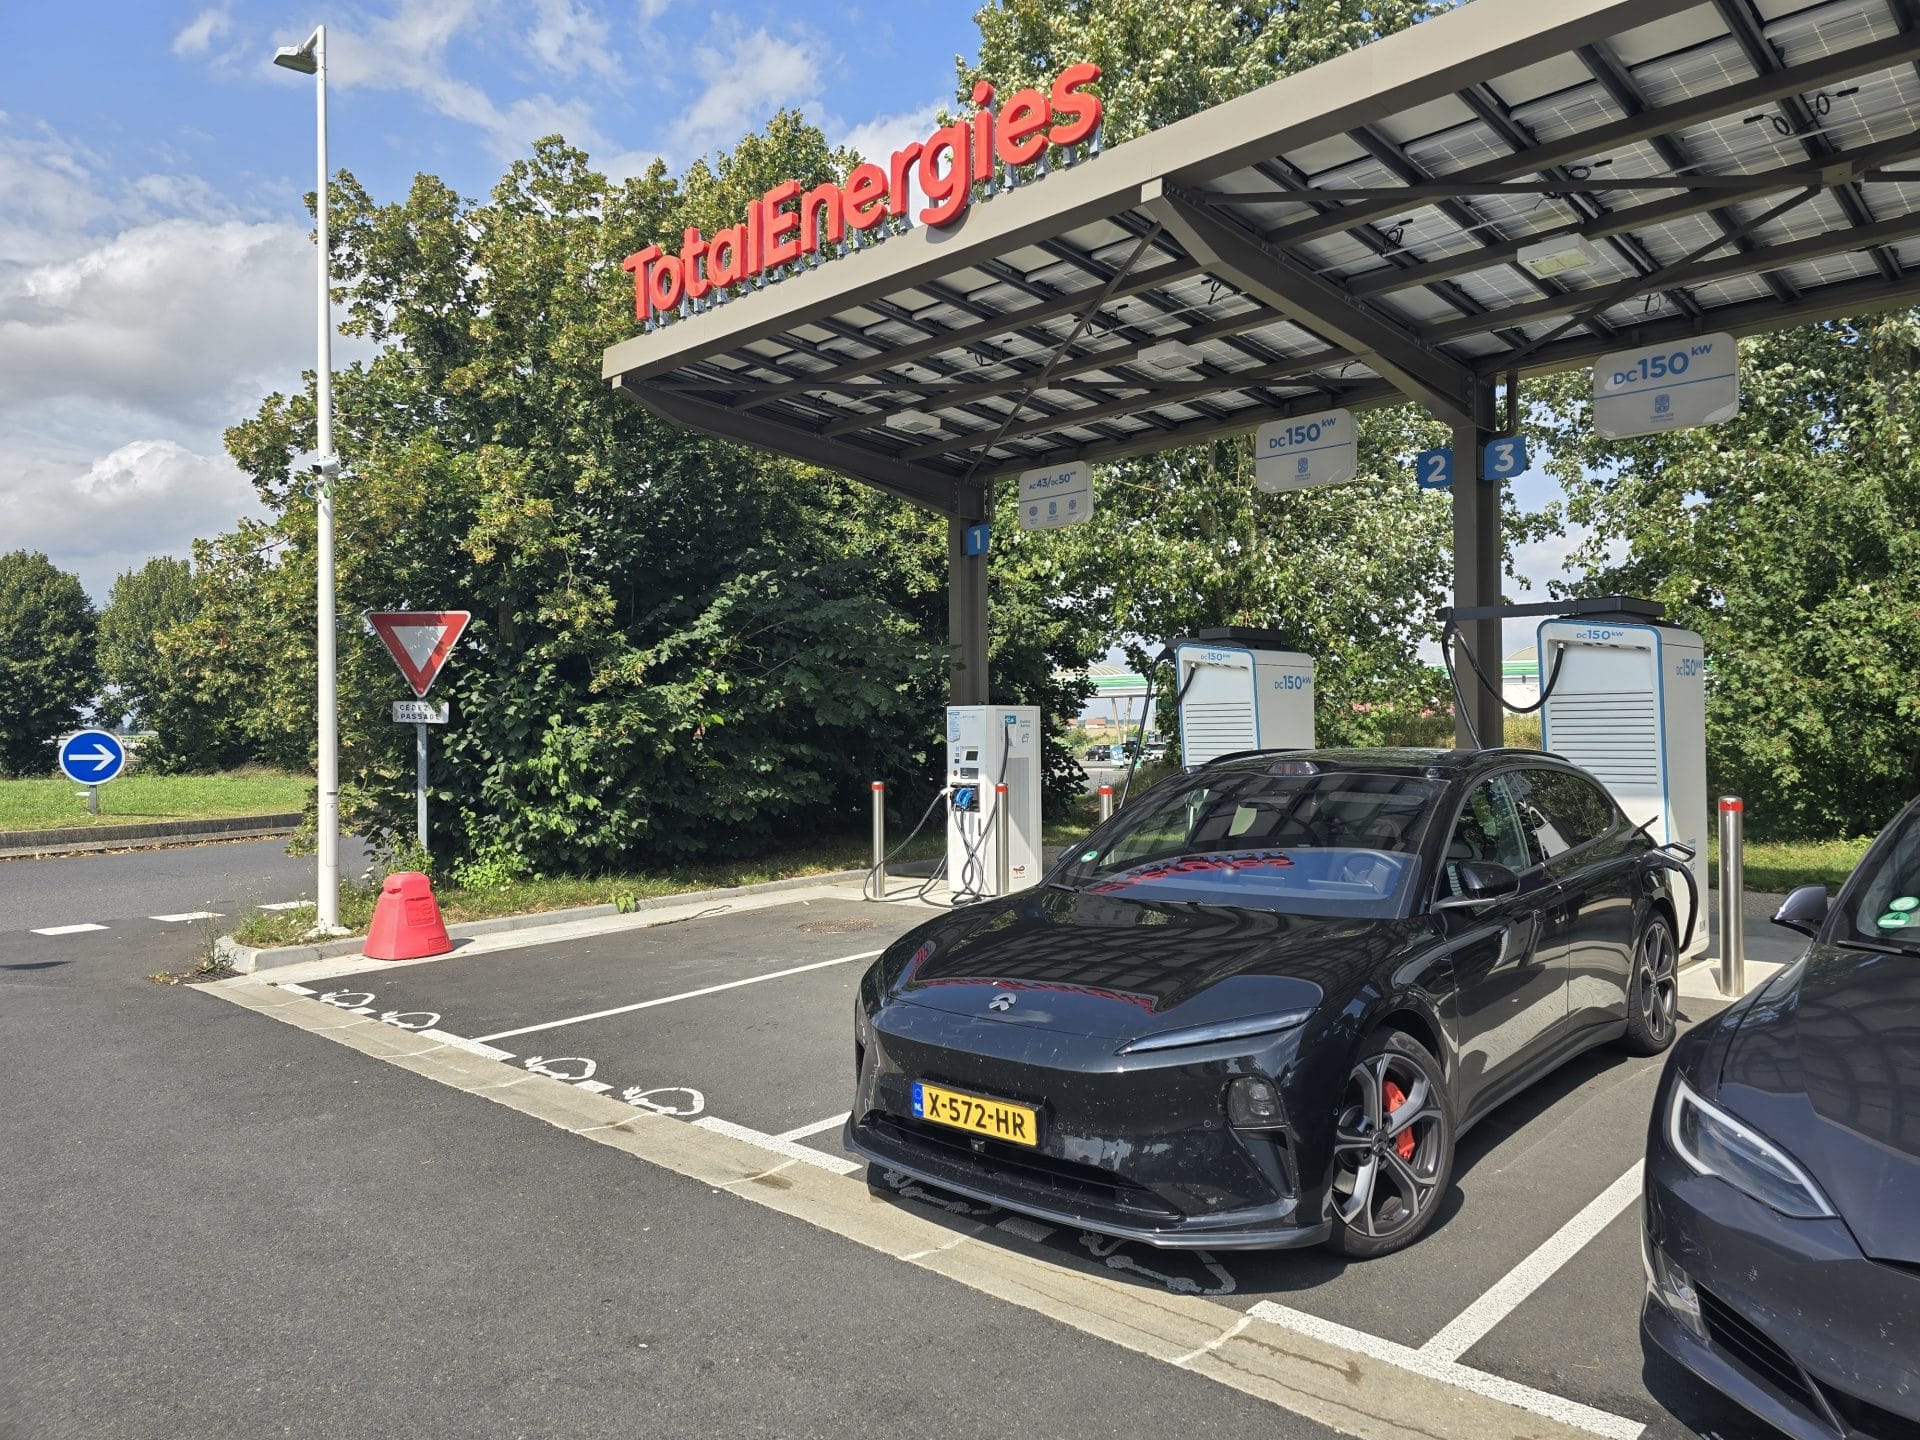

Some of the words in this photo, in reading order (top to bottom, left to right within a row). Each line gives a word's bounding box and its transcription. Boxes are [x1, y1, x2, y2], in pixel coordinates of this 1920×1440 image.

[623, 63, 1102, 322] TotalEnergies
[1427, 455, 1446, 482] 2
[1494, 444, 1514, 472] 3
[974, 529, 981, 549] 1
[914, 1103, 923, 1112] NL
[928, 1092, 1026, 1139] X-572-HR
